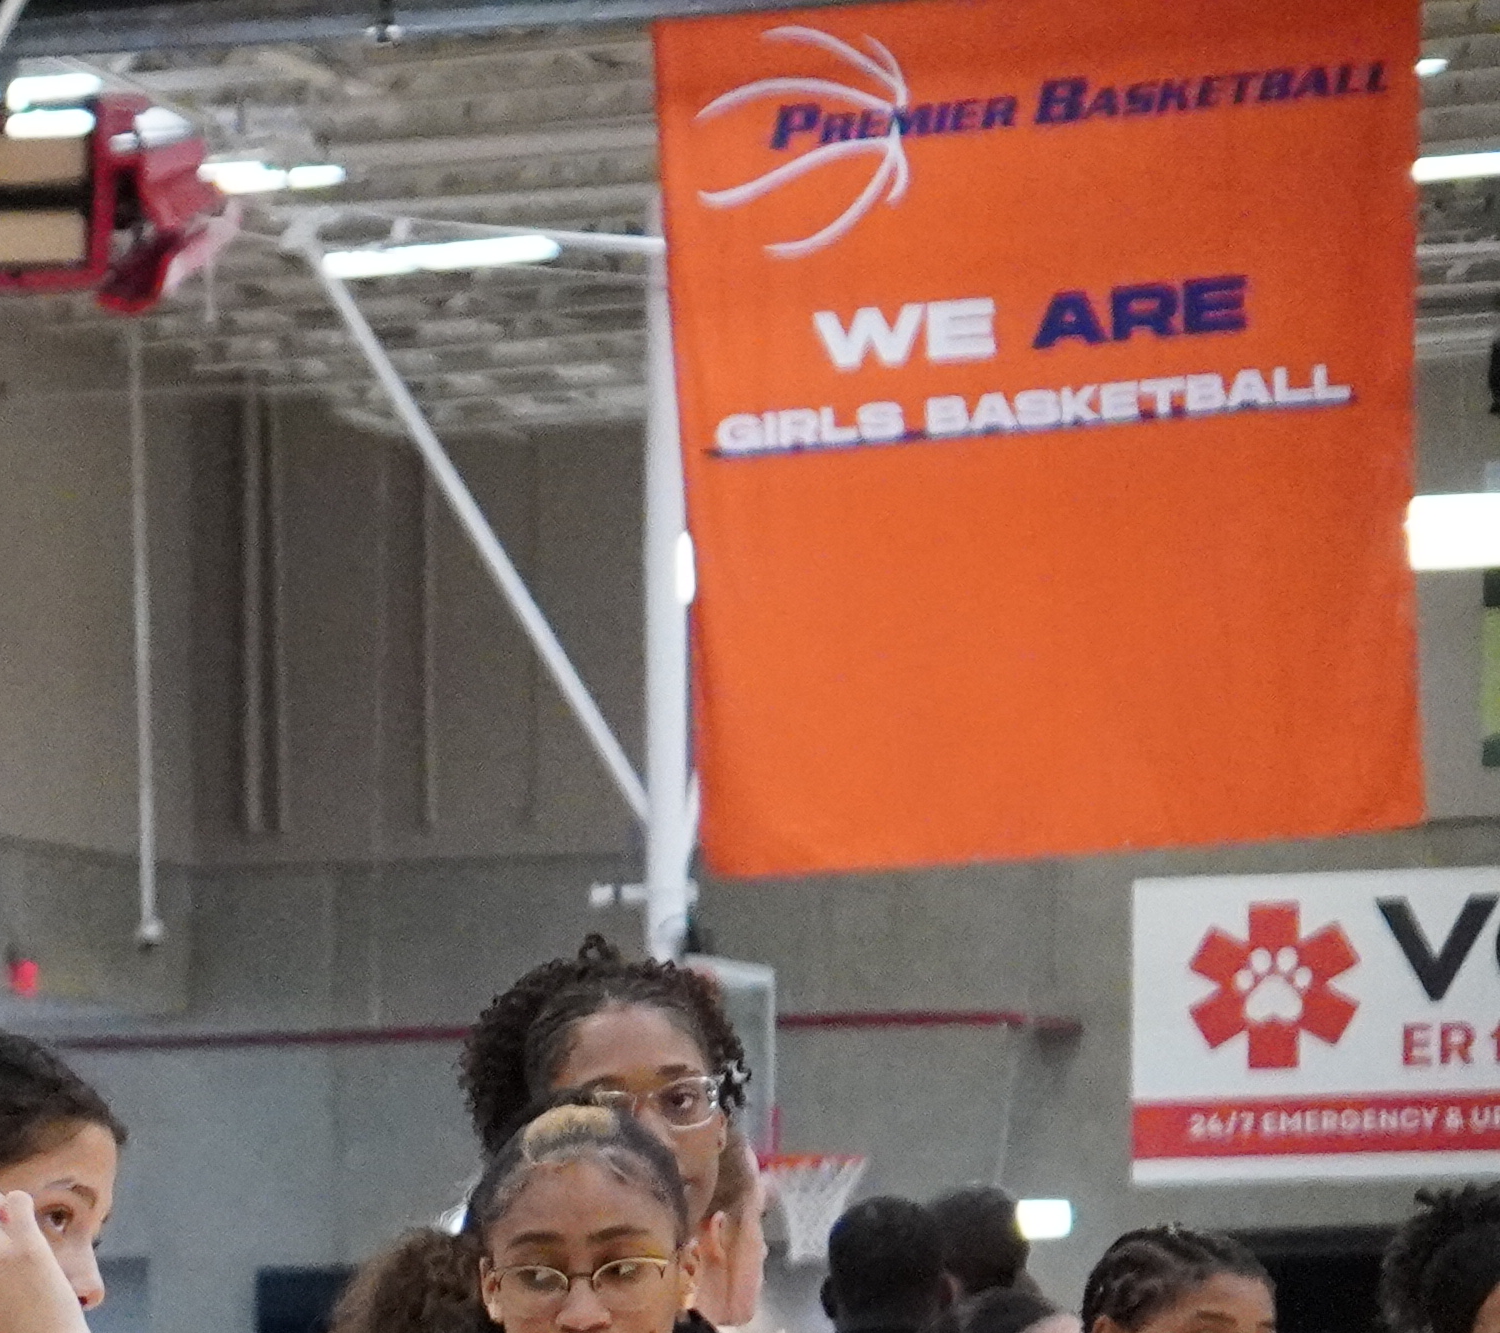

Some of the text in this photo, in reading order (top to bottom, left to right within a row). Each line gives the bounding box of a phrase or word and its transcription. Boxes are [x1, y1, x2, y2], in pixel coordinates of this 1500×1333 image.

[770, 62, 1387, 150] PREMIER BASKETBALL
[814, 276, 1248, 370] WE ARE
[715, 364, 1351, 454] GIRLS BASKETBALL
[1375, 893, 1500, 1001] V
[1403, 1021, 1476, 1066] ER
[1189, 1110, 1255, 1139] 24/7
[1261, 1105, 1439, 1135] EMERGENCY
